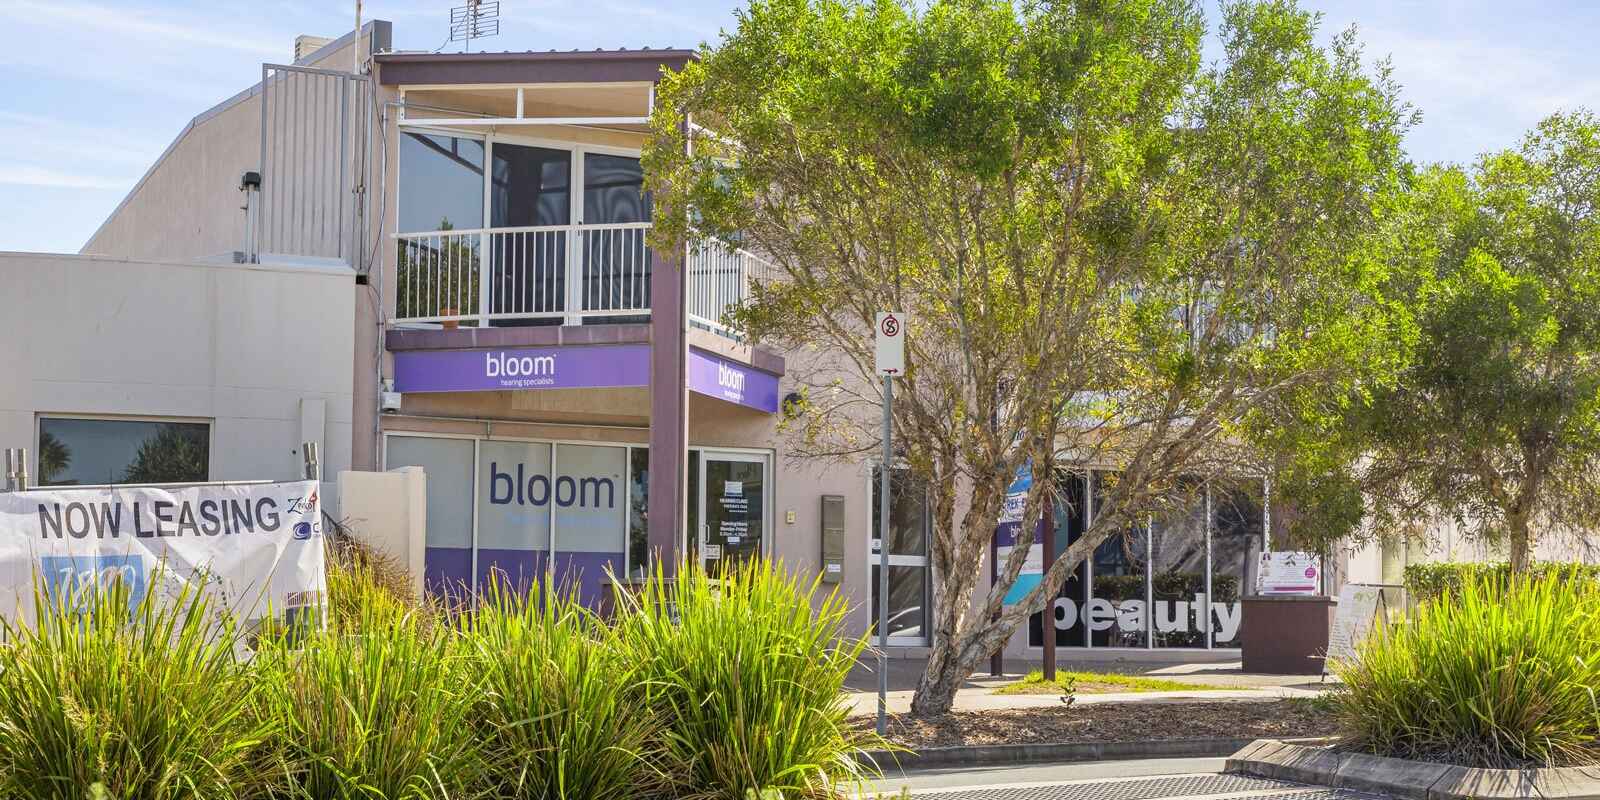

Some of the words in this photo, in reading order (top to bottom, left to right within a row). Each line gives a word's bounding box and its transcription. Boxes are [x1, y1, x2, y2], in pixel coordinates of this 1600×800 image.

[486, 352, 555, 377] bloom
[718, 361, 745, 392] bloom
[501, 379, 523, 387] hearing
[524, 378, 554, 387] specialists
[490, 462, 615, 508] bloom
[38, 501, 121, 539] NOW
[133, 497, 281, 538] LEASING
